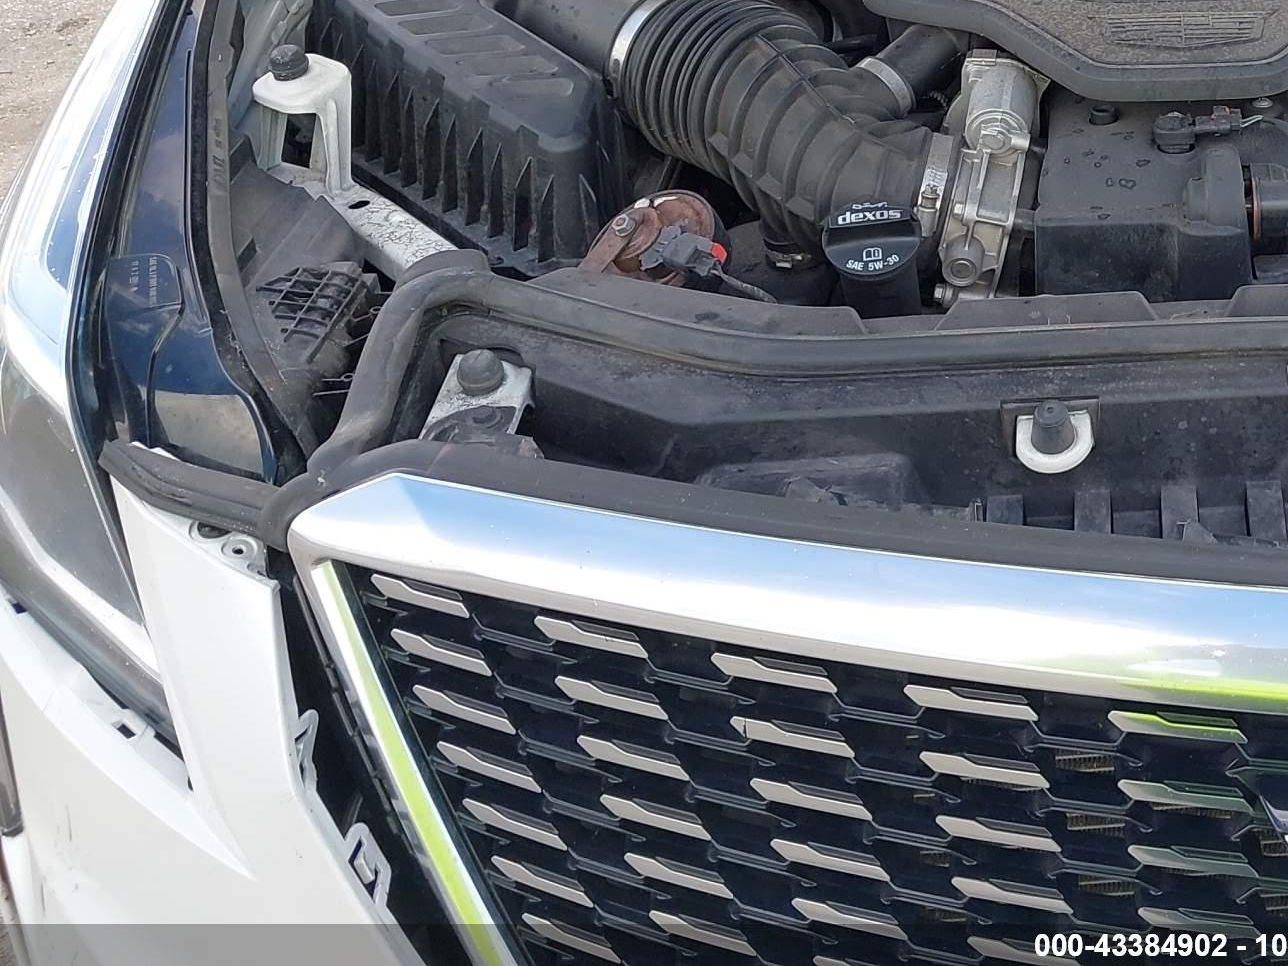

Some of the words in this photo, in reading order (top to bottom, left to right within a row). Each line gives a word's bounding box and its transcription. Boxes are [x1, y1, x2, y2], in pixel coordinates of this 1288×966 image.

[837, 209, 904, 225] dexos
[846, 259, 865, 271] SAE
[868, 253, 900, 271] 5W-30
